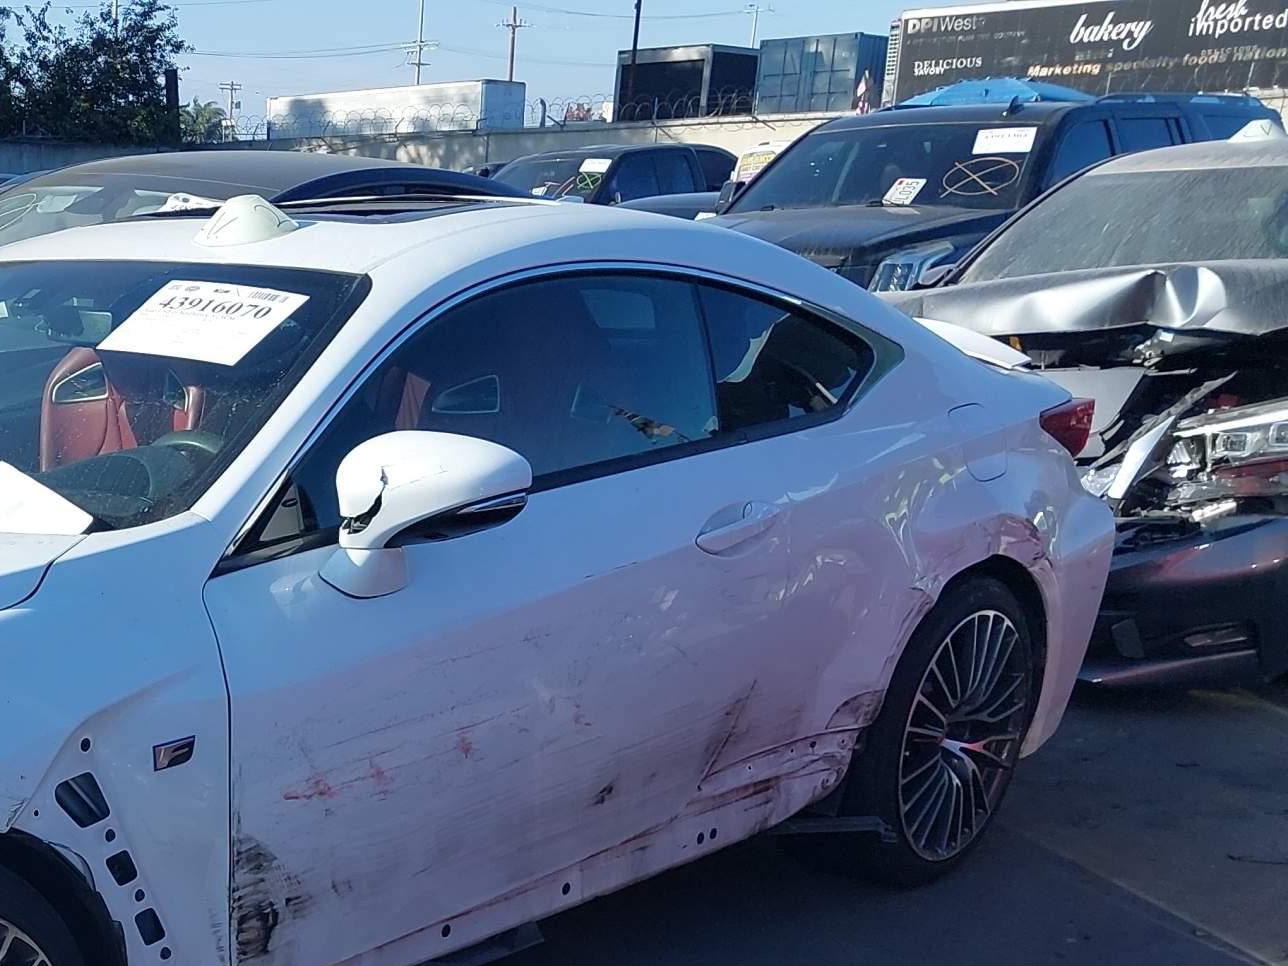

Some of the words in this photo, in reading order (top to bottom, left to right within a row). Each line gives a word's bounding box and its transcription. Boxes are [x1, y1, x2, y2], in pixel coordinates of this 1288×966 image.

[1070, 11, 1155, 51] bakery
[1188, 8, 1288, 39] imported
[913, 56, 983, 71] DELICIOUS
[1027, 62, 1102, 78] Marketing
[159, 295, 273, 320] 43916070
